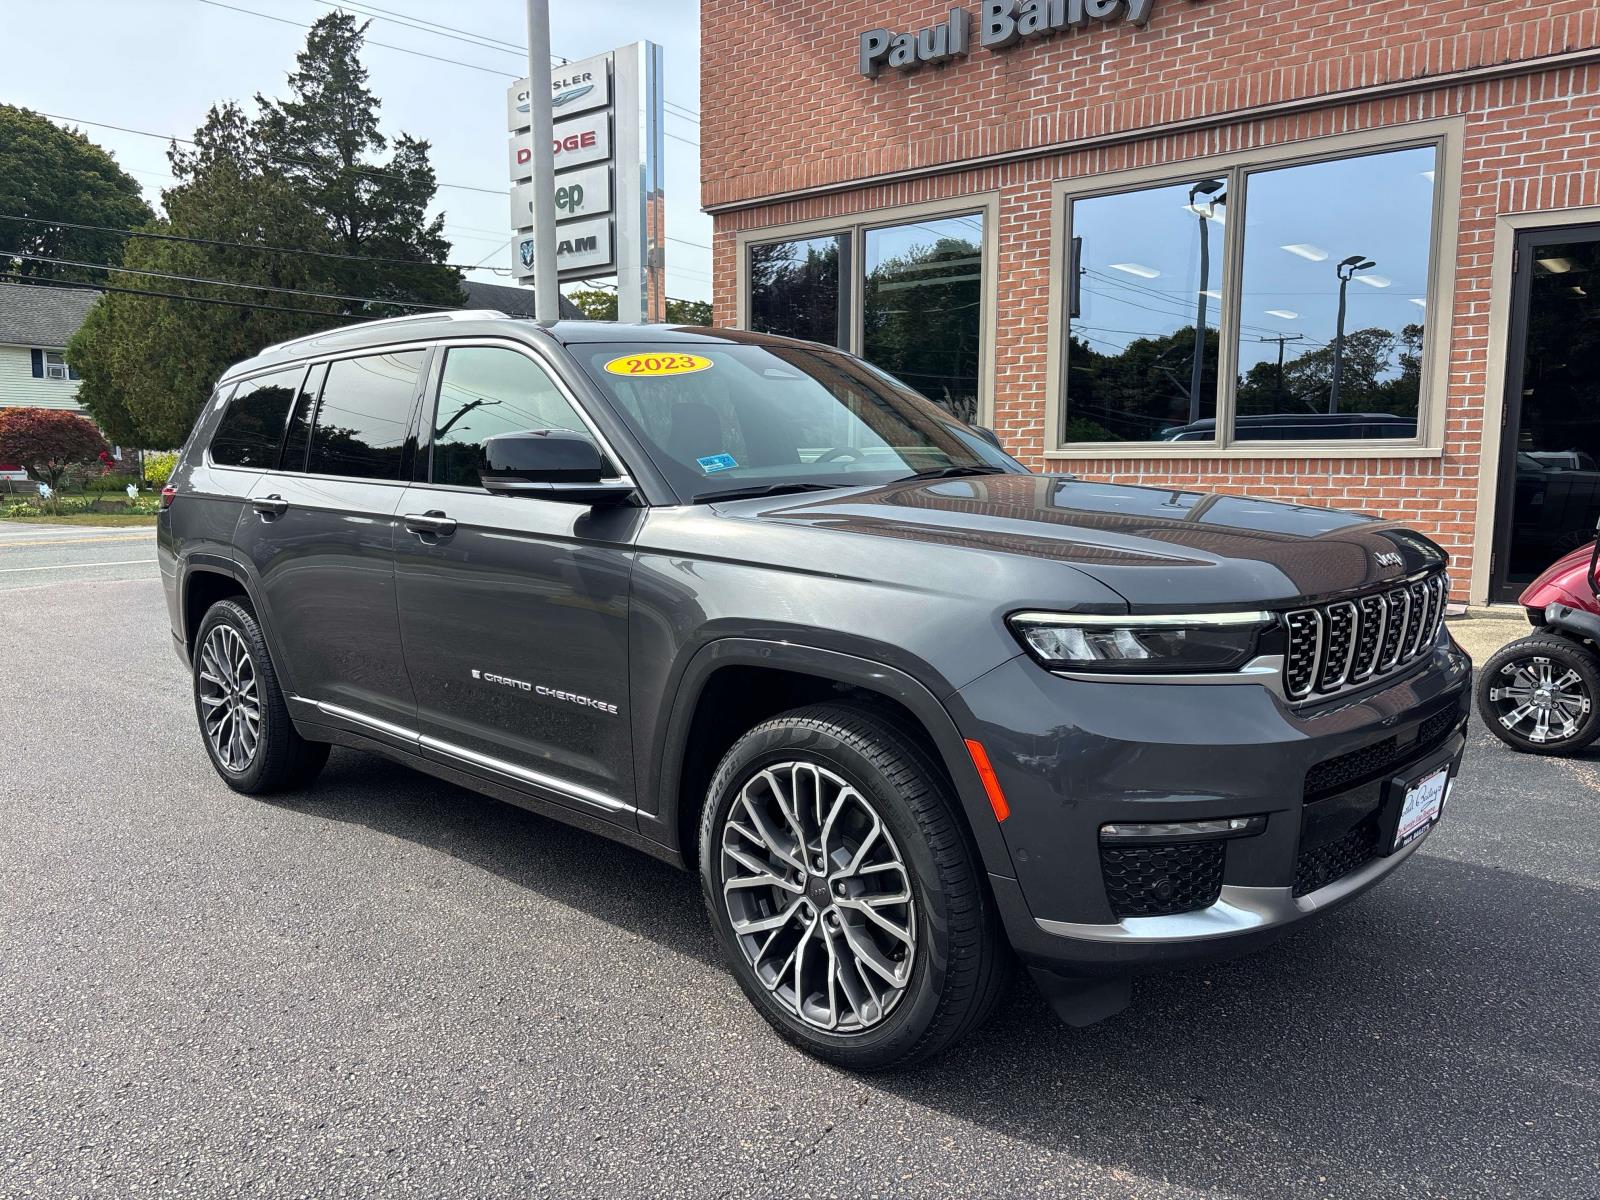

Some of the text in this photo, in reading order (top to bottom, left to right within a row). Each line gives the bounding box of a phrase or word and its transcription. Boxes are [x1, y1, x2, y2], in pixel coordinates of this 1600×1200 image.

[859, 7, 969, 78] Paul
[518, 72, 592, 101] CSLER
[517, 130, 596, 165] DDGE
[529, 184, 584, 213] ep
[557, 235, 597, 256] AM
[627, 356, 696, 374] 2023
[484, 672, 618, 715] GRAND CHEROKEE
